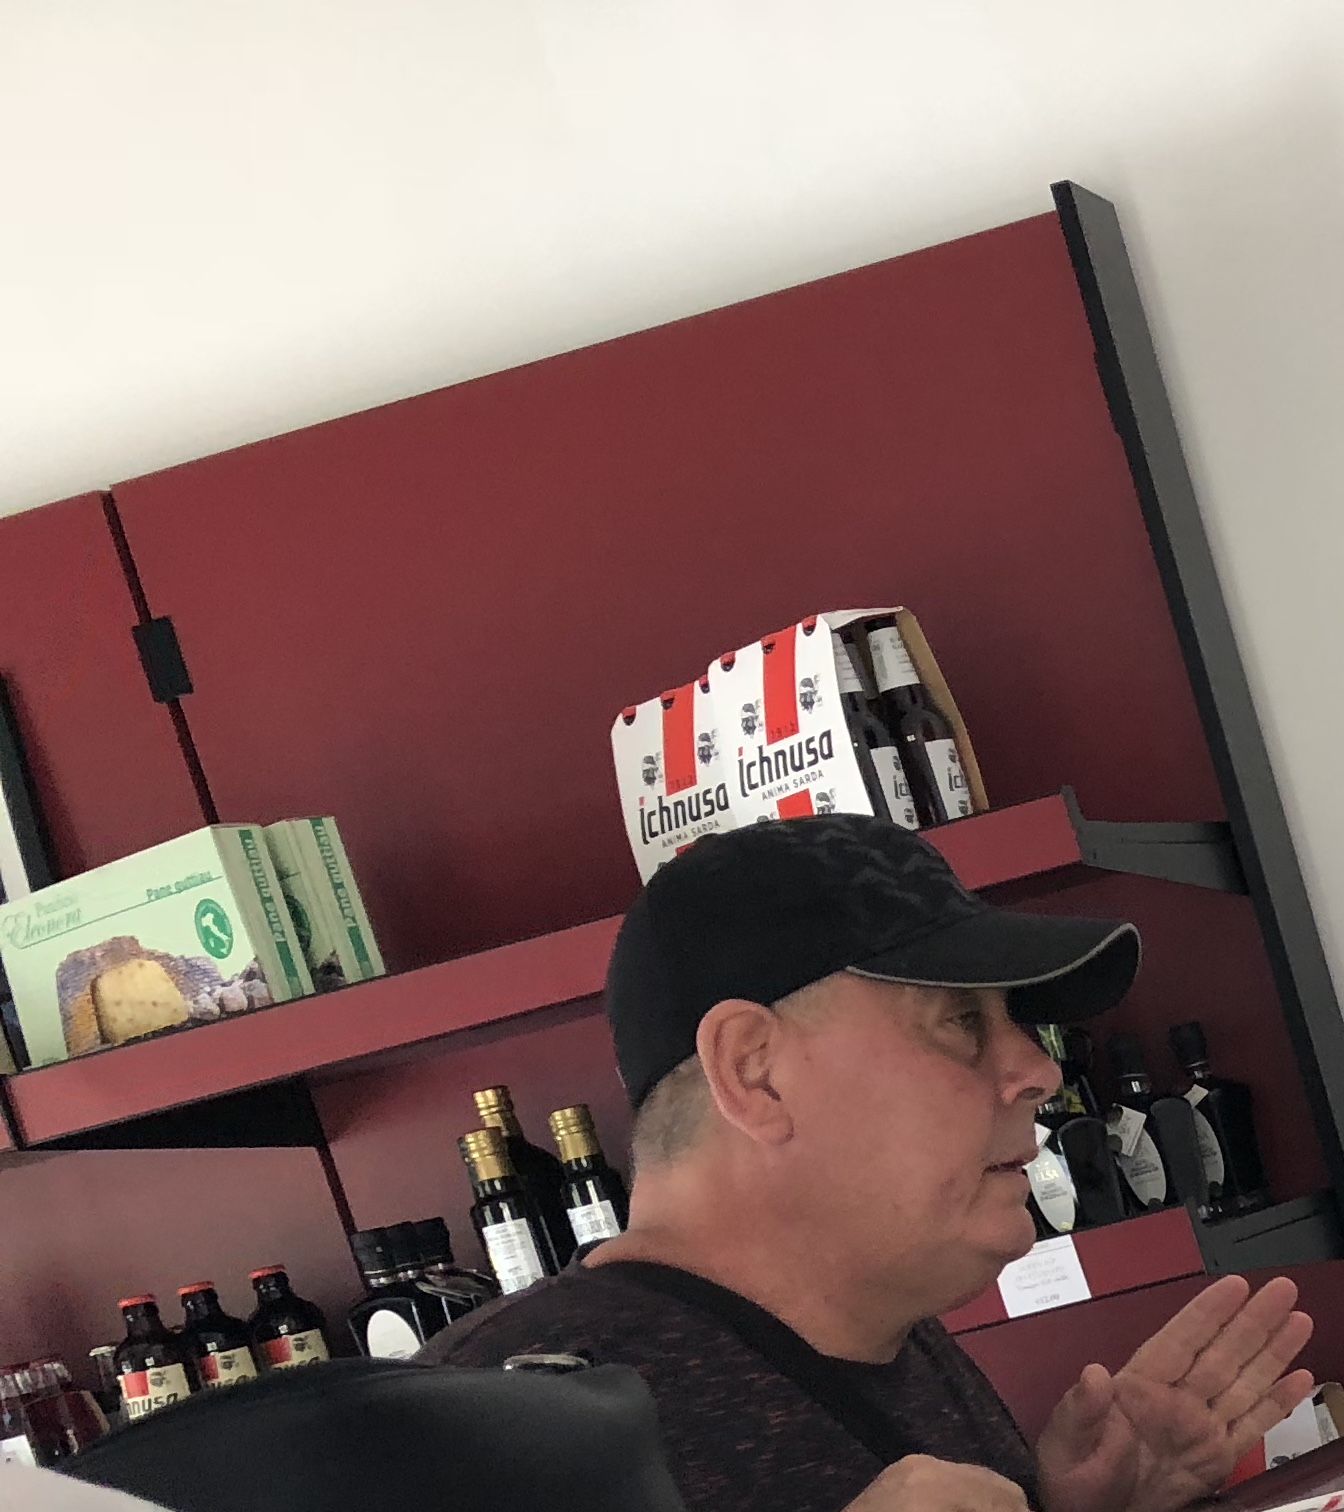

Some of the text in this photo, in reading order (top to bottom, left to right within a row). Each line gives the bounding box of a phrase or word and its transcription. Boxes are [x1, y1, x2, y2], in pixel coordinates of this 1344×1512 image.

[761, 769, 825, 801] ANIMA SARDA
[661, 819, 721, 849] ANIMA SARDA
